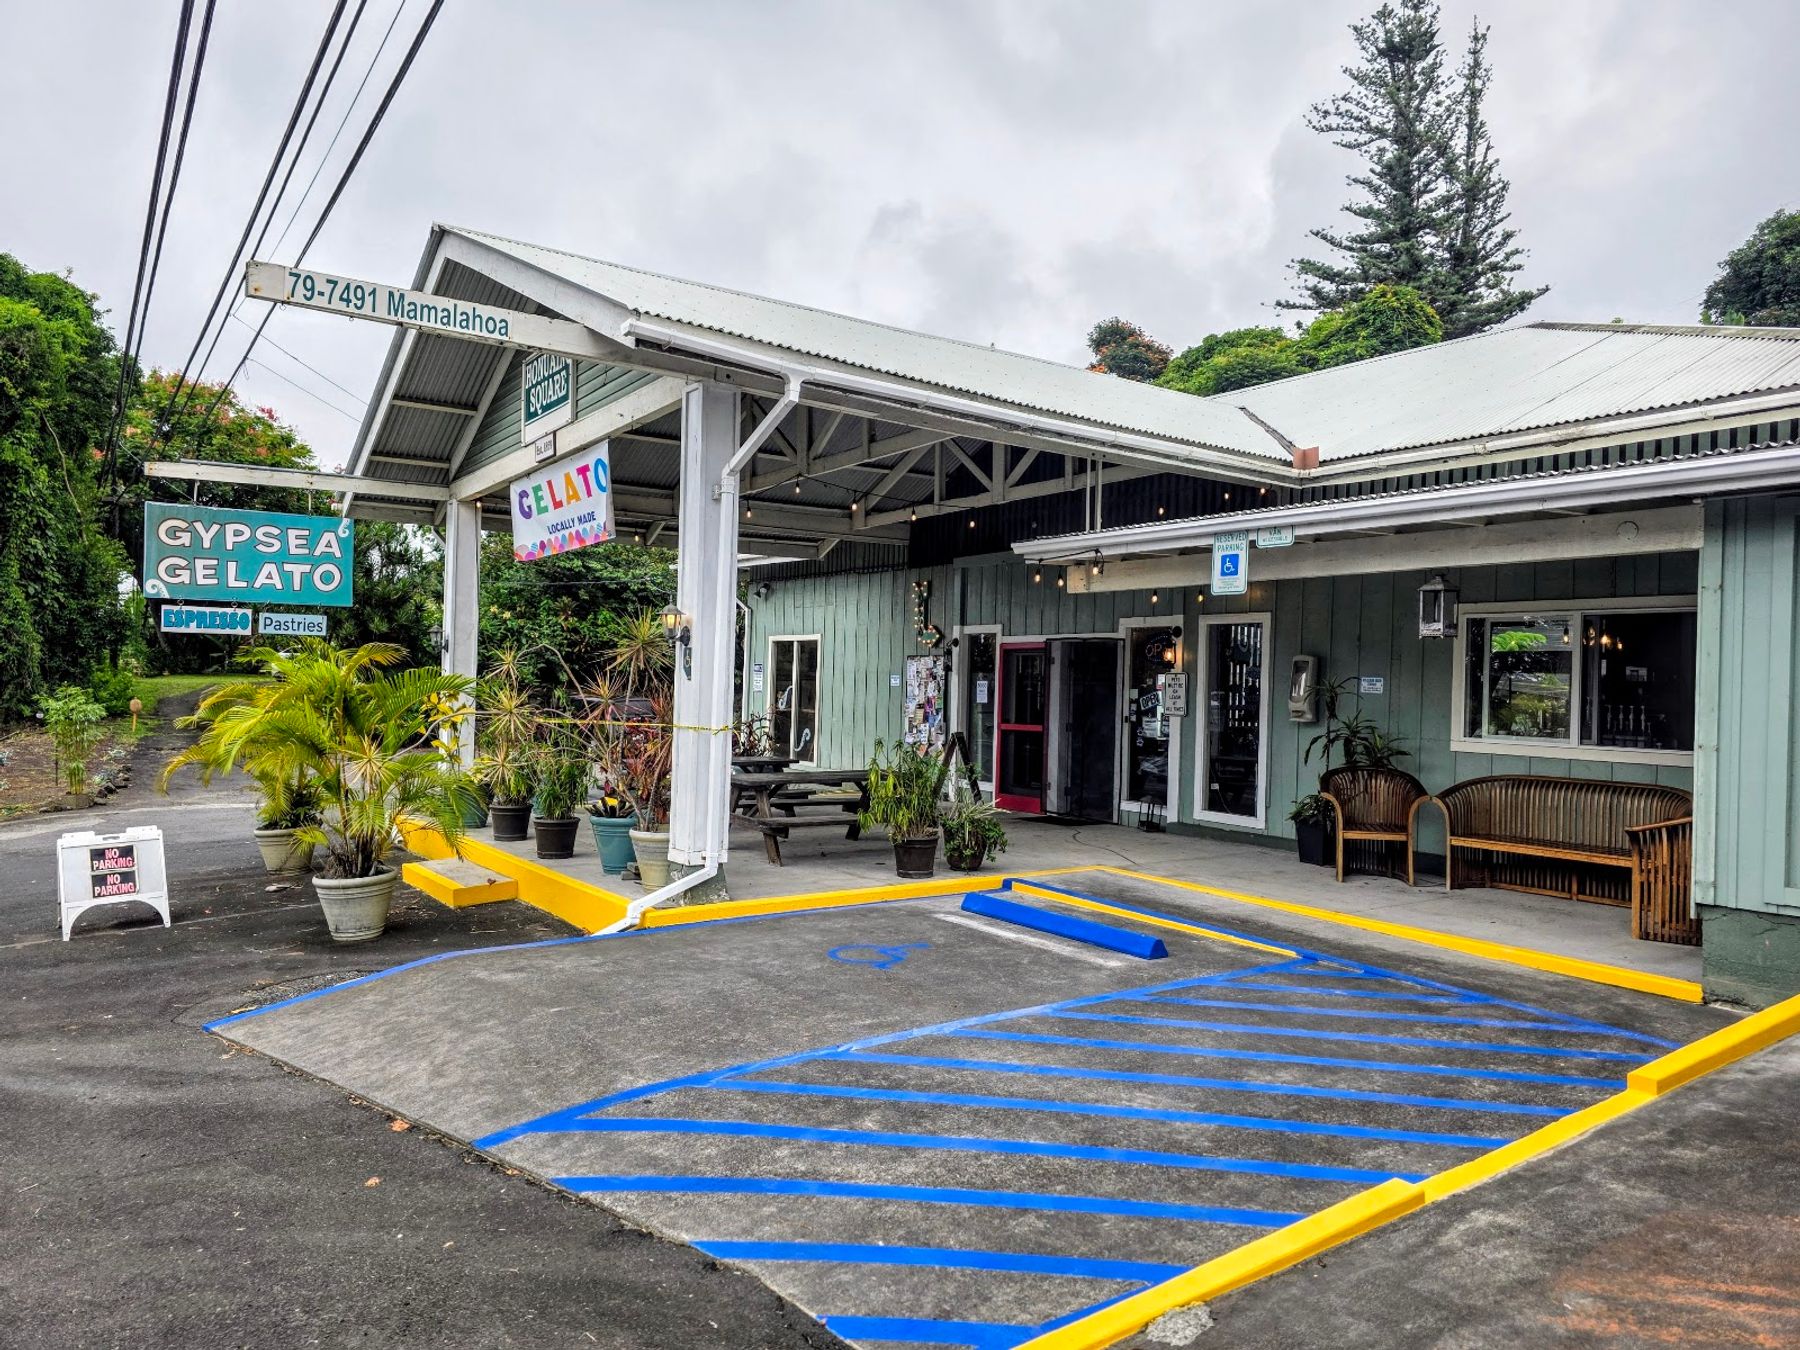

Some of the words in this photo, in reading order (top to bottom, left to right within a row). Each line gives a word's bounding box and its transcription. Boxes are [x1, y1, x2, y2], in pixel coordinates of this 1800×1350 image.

[287, 271, 377, 314] 79-7491
[386, 289, 510, 338] Mamalahoa
[525, 353, 571, 389] HONUAI
[529, 370, 567, 415] SQUARE
[518, 458, 608, 520] GELATO
[547, 518, 576, 535] LOCALLY
[576, 511, 596, 526] MADE
[1269, 527, 1282, 536] VAN
[157, 517, 342, 559] GYPSEA
[1216, 530, 1247, 543] RESERVED
[1217, 543, 1245, 553] PARKING
[157, 555, 342, 593] GELATO
[163, 608, 251, 630] ESPRESSO
[264, 616, 323, 633] Pastries
[93, 857, 133, 870] PARKING
[105, 848, 119, 860] NO
[107, 874, 121, 885] NO
[94, 882, 135, 897] PARKING
